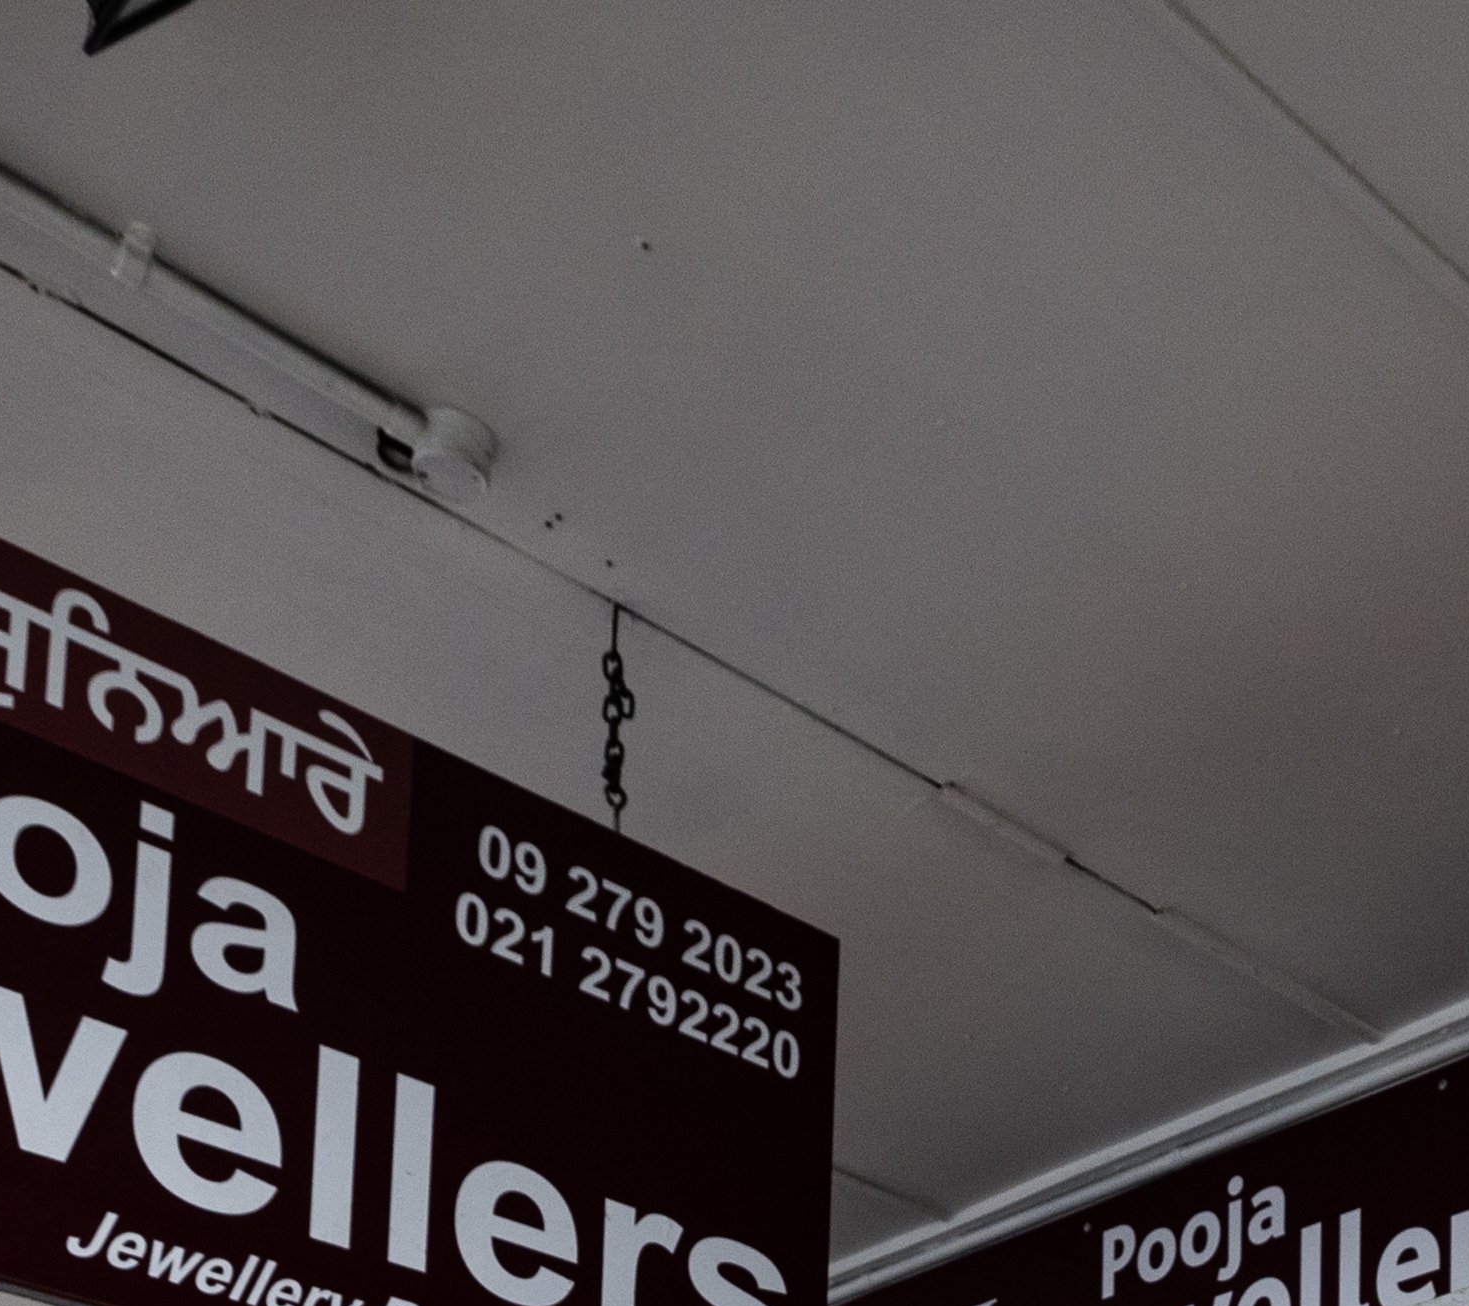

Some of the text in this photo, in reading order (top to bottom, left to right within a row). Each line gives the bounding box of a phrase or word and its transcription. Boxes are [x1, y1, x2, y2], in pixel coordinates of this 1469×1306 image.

[454, 891, 802, 1079] 021 2792220
[477, 824, 803, 1012] 09 279 2023
[1101, 1174, 1287, 1300] Pooja
